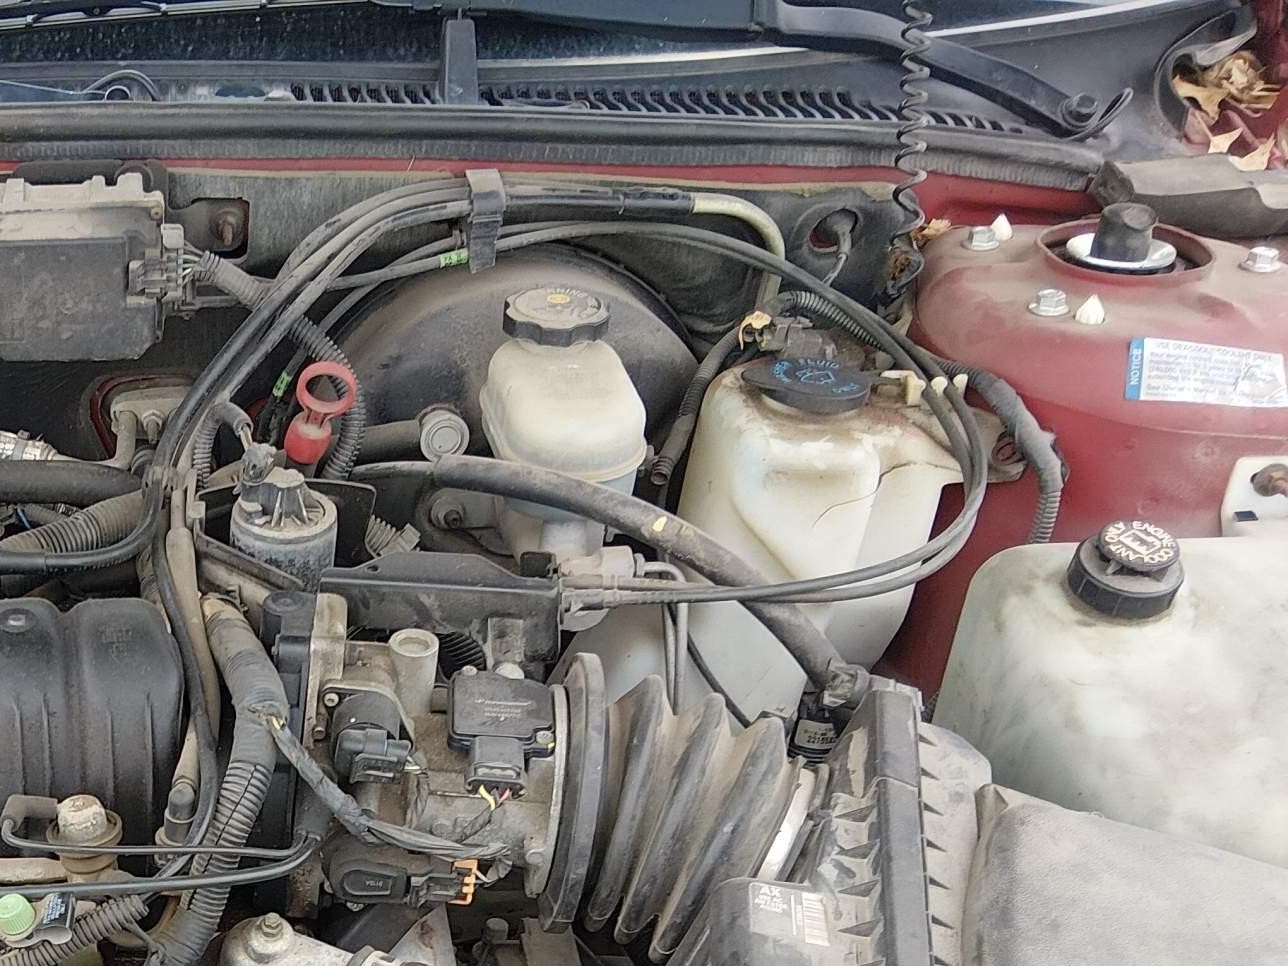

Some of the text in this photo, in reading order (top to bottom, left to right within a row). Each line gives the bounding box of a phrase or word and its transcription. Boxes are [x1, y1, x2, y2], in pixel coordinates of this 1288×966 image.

[1130, 349, 1142, 385] NOTICE
[1105, 521, 1126, 543] ONLY
[1132, 521, 1175, 548] ENGINE
[1109, 544, 1174, 564] COOLANT
